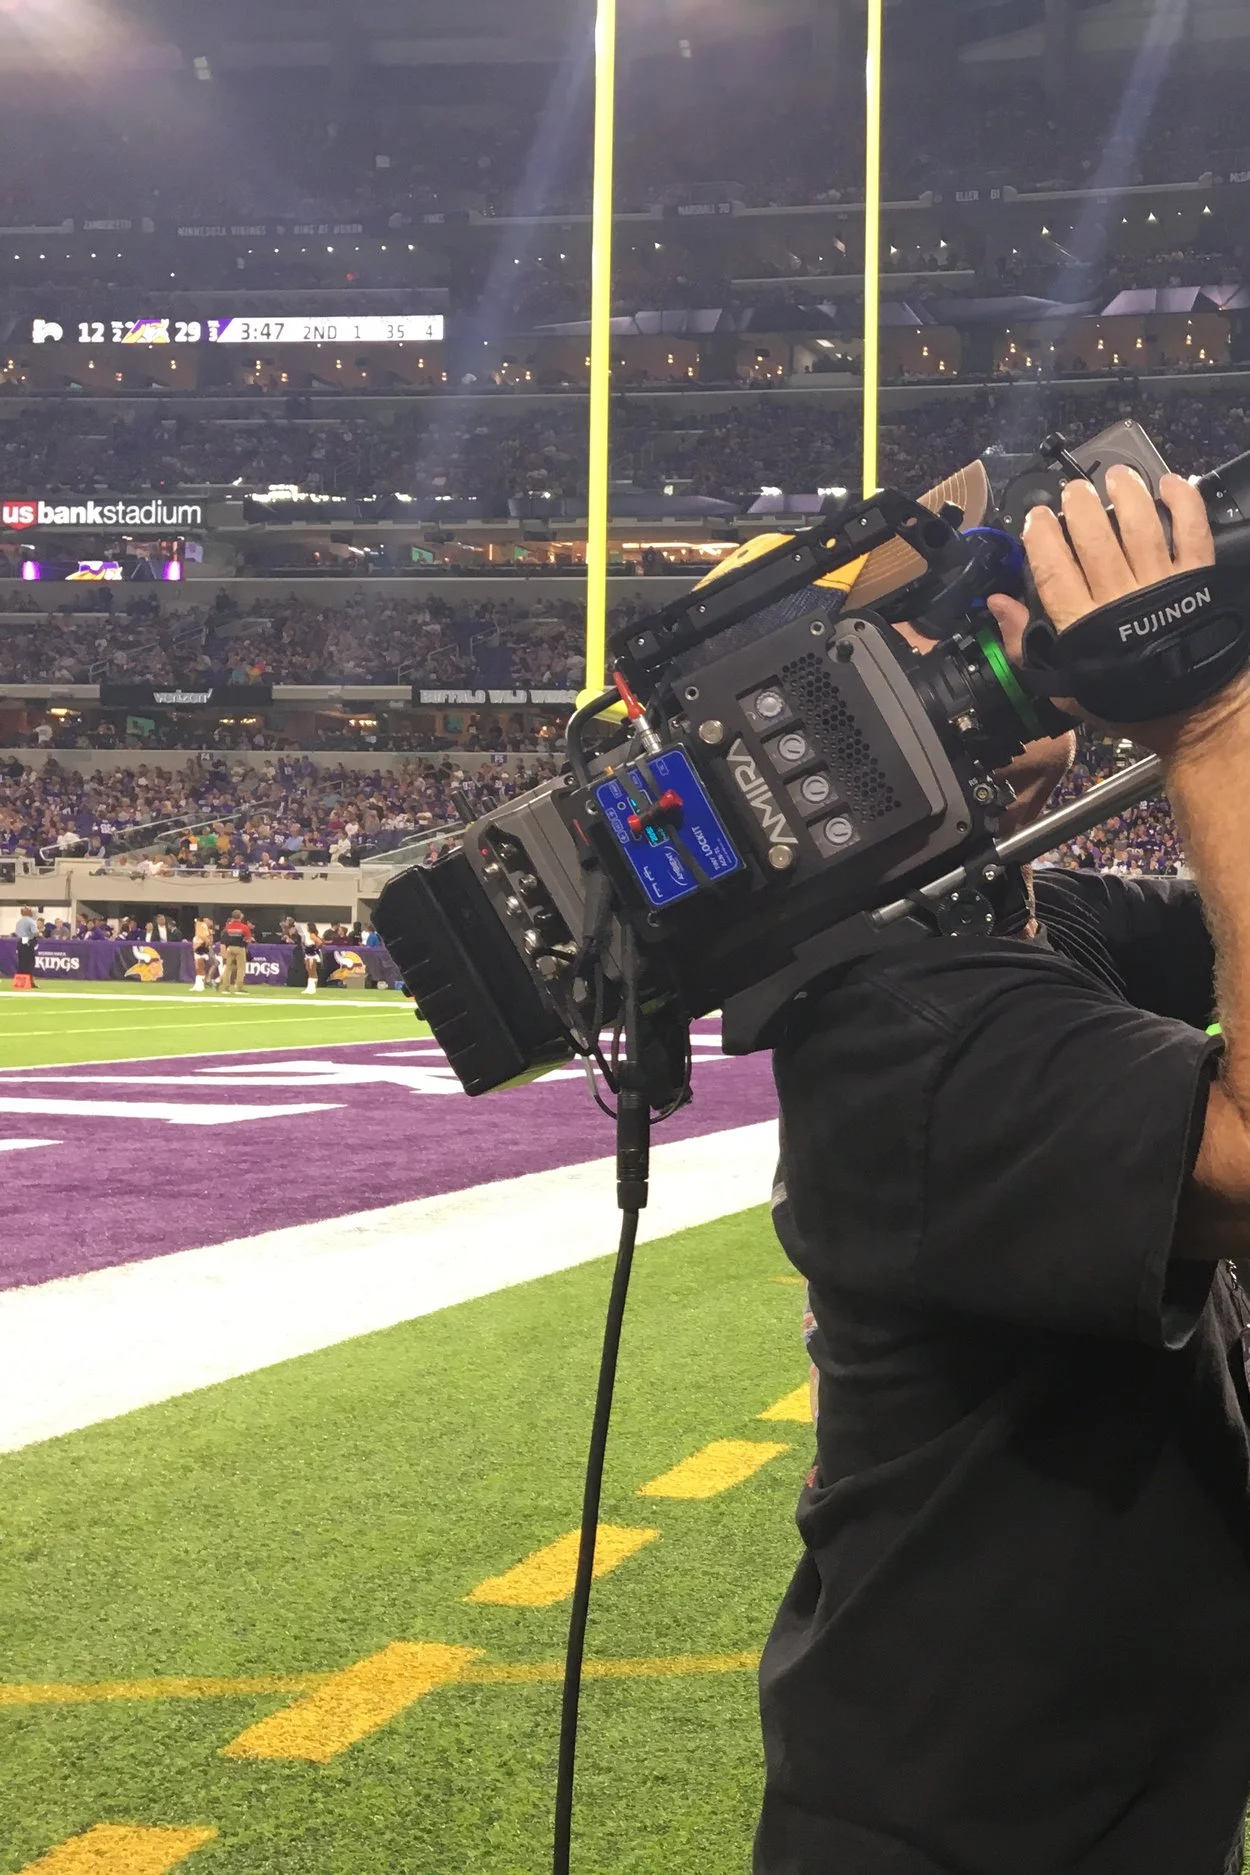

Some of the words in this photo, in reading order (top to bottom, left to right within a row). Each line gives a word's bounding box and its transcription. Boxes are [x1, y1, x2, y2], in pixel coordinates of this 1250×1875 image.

[78, 322, 105, 343] 12
[174, 322, 201, 343] 29
[240, 322, 285, 341] 3:47
[303, 325, 338, 340] 2ND
[353, 325, 361, 339] 1
[386, 324, 405, 339] 35
[425, 324, 433, 338] 4
[1119, 587, 1212, 642] FUJINON
[153, 689, 211, 704] verizon
[419, 689, 486, 703] BUFFALO
[488, 689, 527, 703] WILD
[726, 738, 799, 844] AMIRA
[691, 825, 713, 858] LOCKIT
[34, 956, 80, 972] KINGS
[245, 962, 279, 977] INGS
